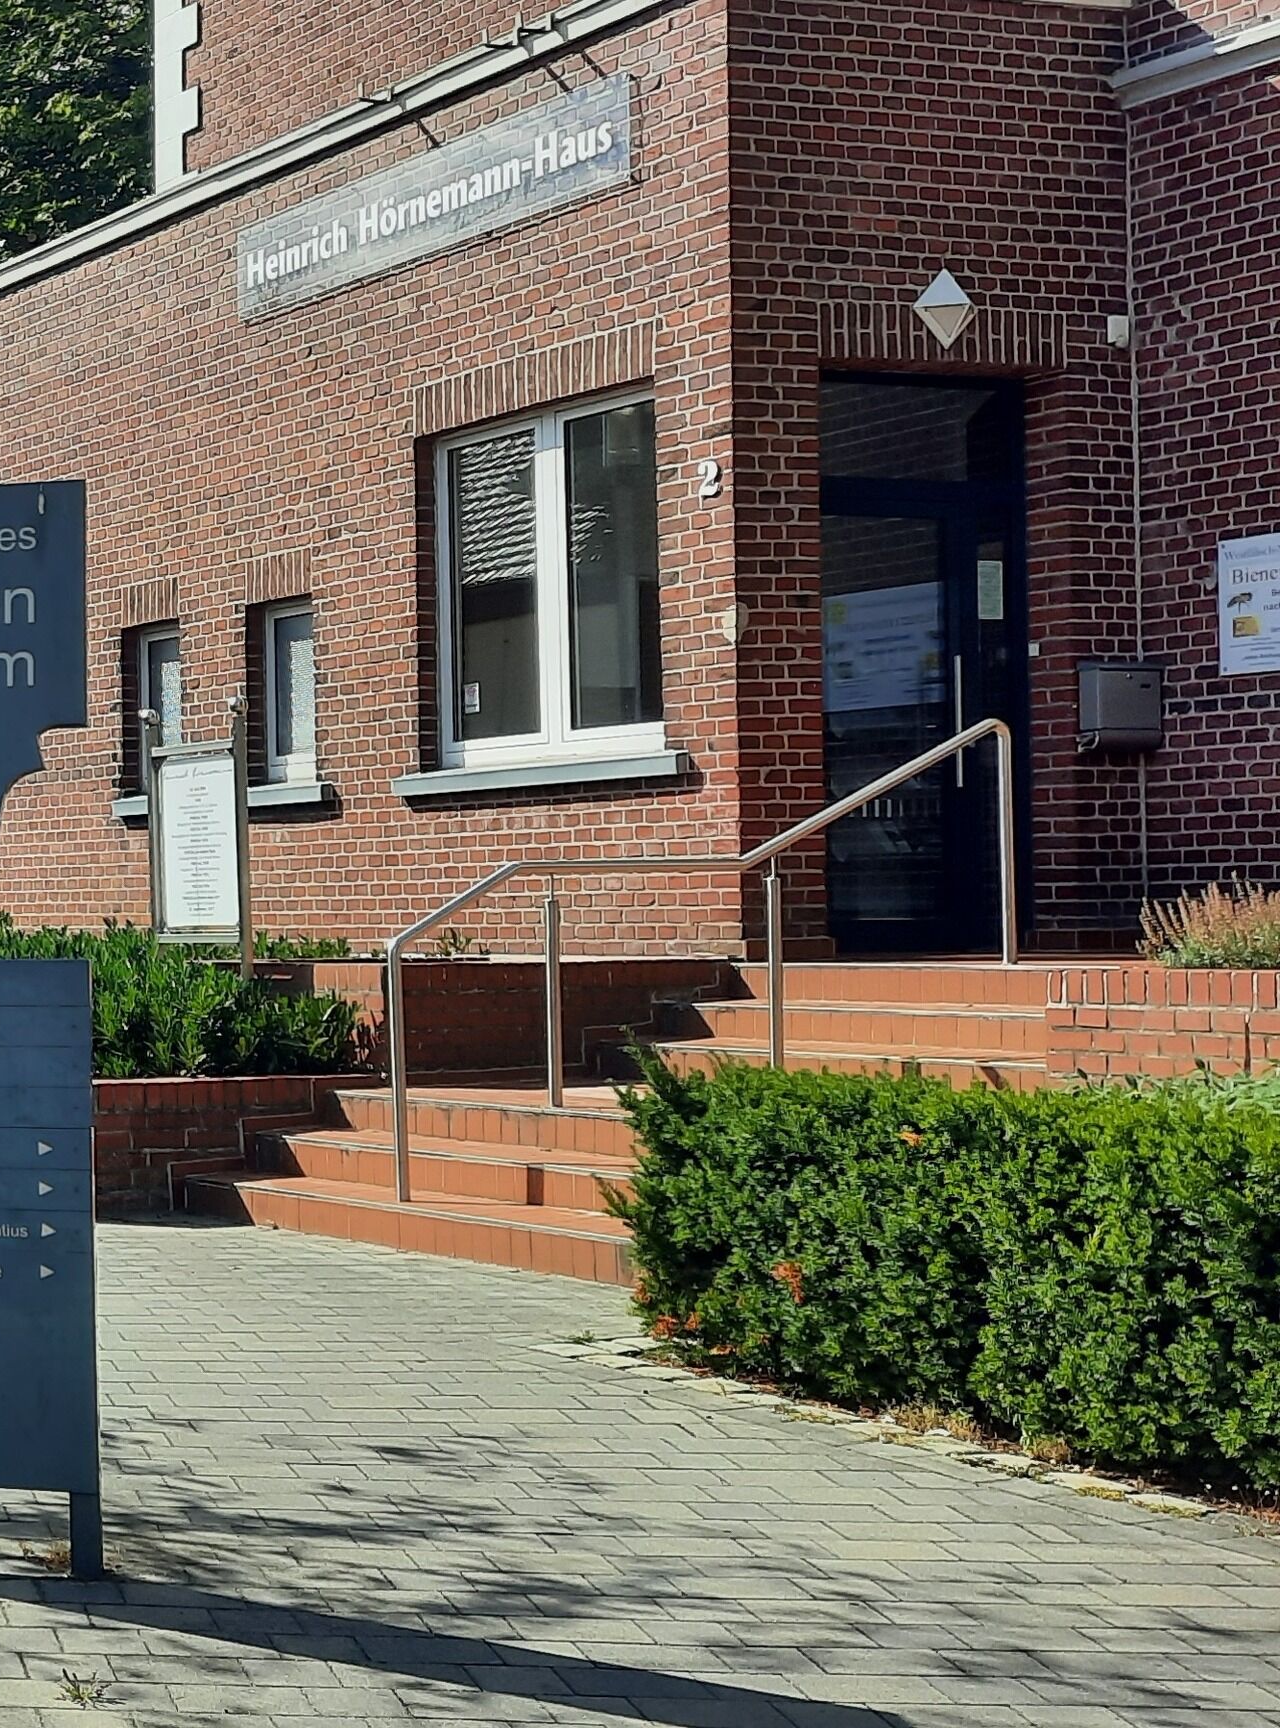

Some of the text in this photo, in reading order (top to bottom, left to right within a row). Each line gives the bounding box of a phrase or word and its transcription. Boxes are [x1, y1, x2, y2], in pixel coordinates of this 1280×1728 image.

[245, 119, 614, 288] Heinrich Hörnemann-Haus
[697, 460, 720, 496] 2
